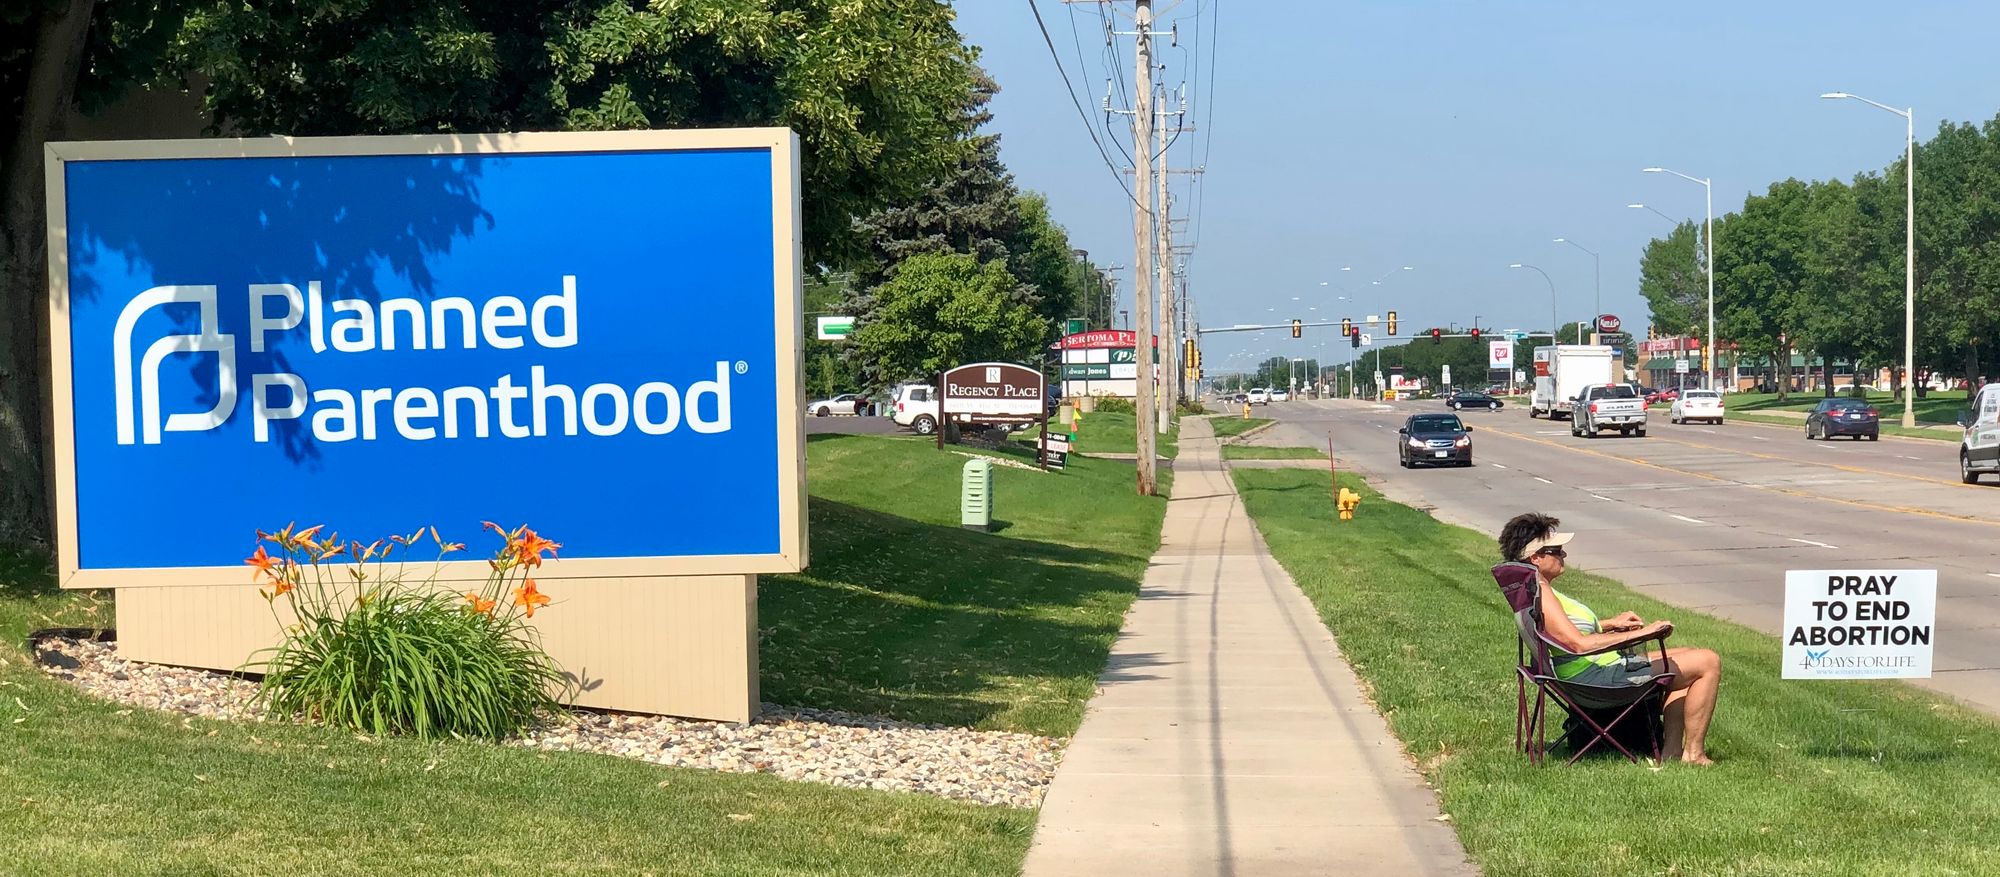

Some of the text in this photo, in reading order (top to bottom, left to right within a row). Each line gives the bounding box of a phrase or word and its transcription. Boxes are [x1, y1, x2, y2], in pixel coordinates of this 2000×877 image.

[248, 275, 579, 353] Planned
[1087, 367, 1107, 375] Jones
[949, 383, 1038, 397] REGENCY PLACE
[1827, 575, 1898, 596] PRAY
[1812, 601, 1910, 621] TO END
[1788, 625, 1930, 646] ABORTION
[1822, 656, 1855, 668] DAYS
[1857, 656, 1885, 668] FOR
[1886, 656, 1917, 668] LIFE
